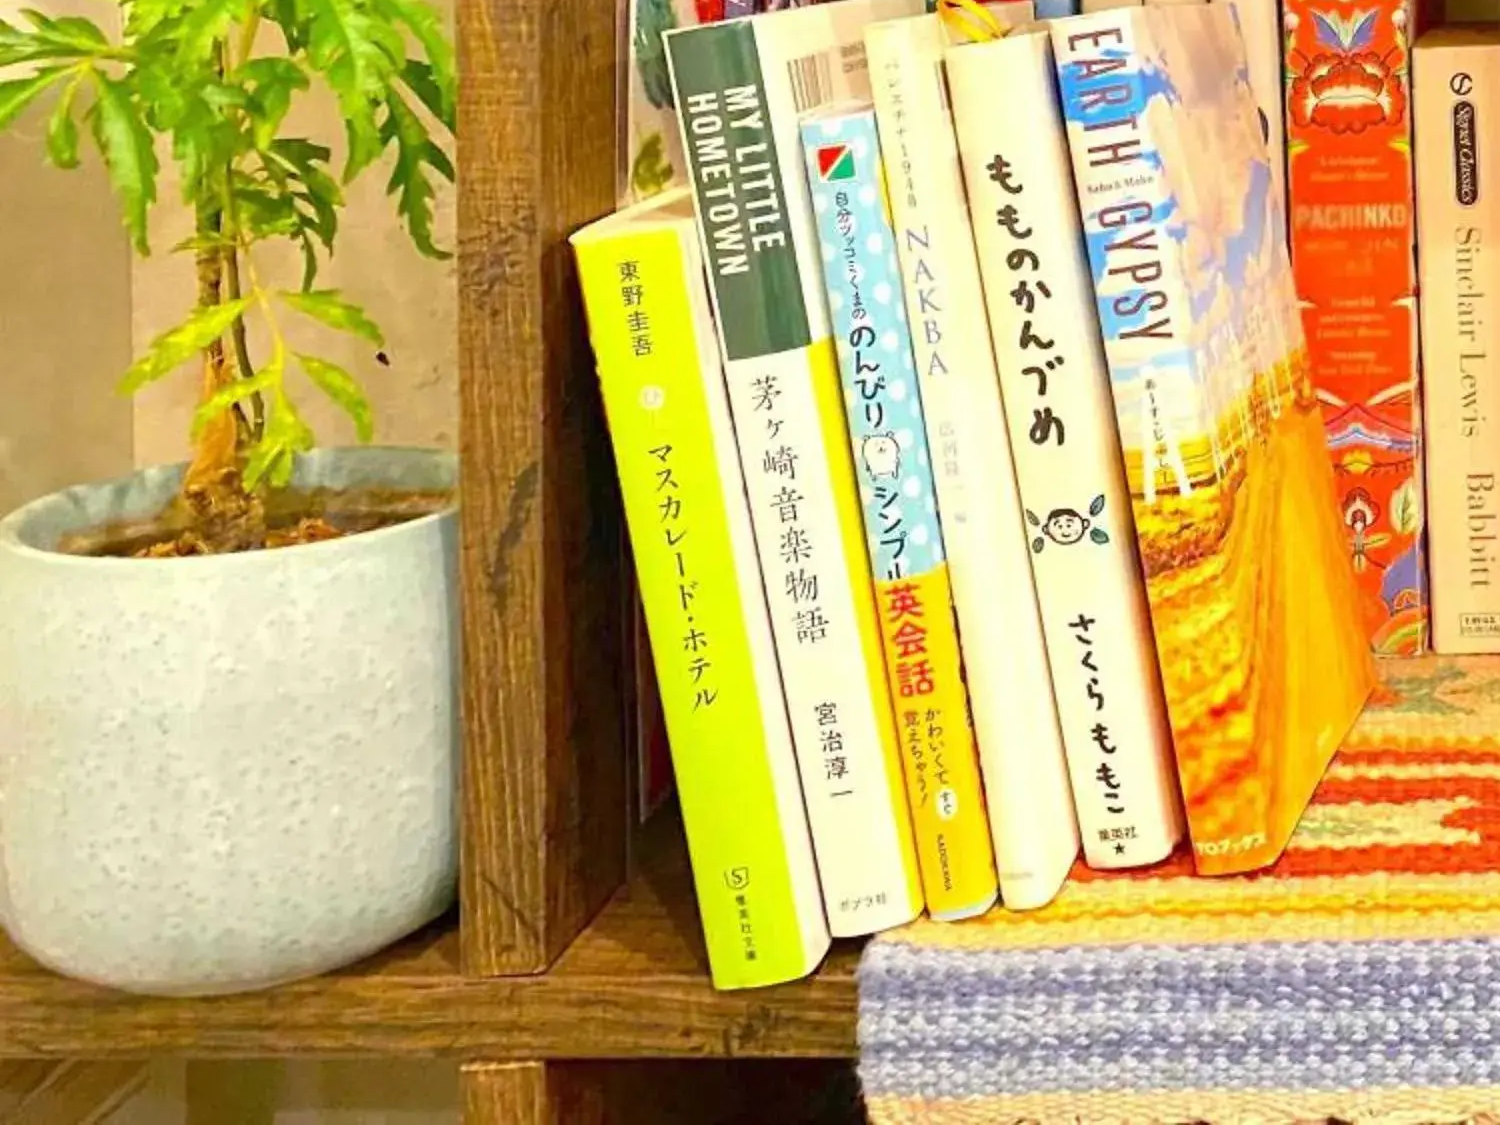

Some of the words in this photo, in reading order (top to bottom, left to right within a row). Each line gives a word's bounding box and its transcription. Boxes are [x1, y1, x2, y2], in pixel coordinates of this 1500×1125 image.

[724, 83, 763, 131] MY
[1068, 27, 1142, 168] EARTH
[687, 91, 750, 277] HOMETOWN
[735, 140, 786, 253] LITTLE
[1295, 203, 1407, 231] PACHINKO
[1459, 148, 1475, 204] Classics
[616, 259, 652, 357] 東野圭吾
[905, 225, 949, 377] NAKBA
[985, 153, 1065, 447] もものかんづめ
[1099, 202, 1174, 341] GYPSY
[1455, 226, 1486, 344] Sinclair
[1458, 353, 1487, 438] Lewis
[750, 373, 830, 645] 茅ヶ崎音楽物語
[849, 325, 887, 429] のんびり
[883, 582, 935, 699] 英会話
[1465, 472, 1497, 589] Babbitt
[648, 443, 718, 716] マスカレード・ホテル
[814, 701, 854, 799] 宮治淳一
[1068, 612, 1126, 814] さくらももこ
